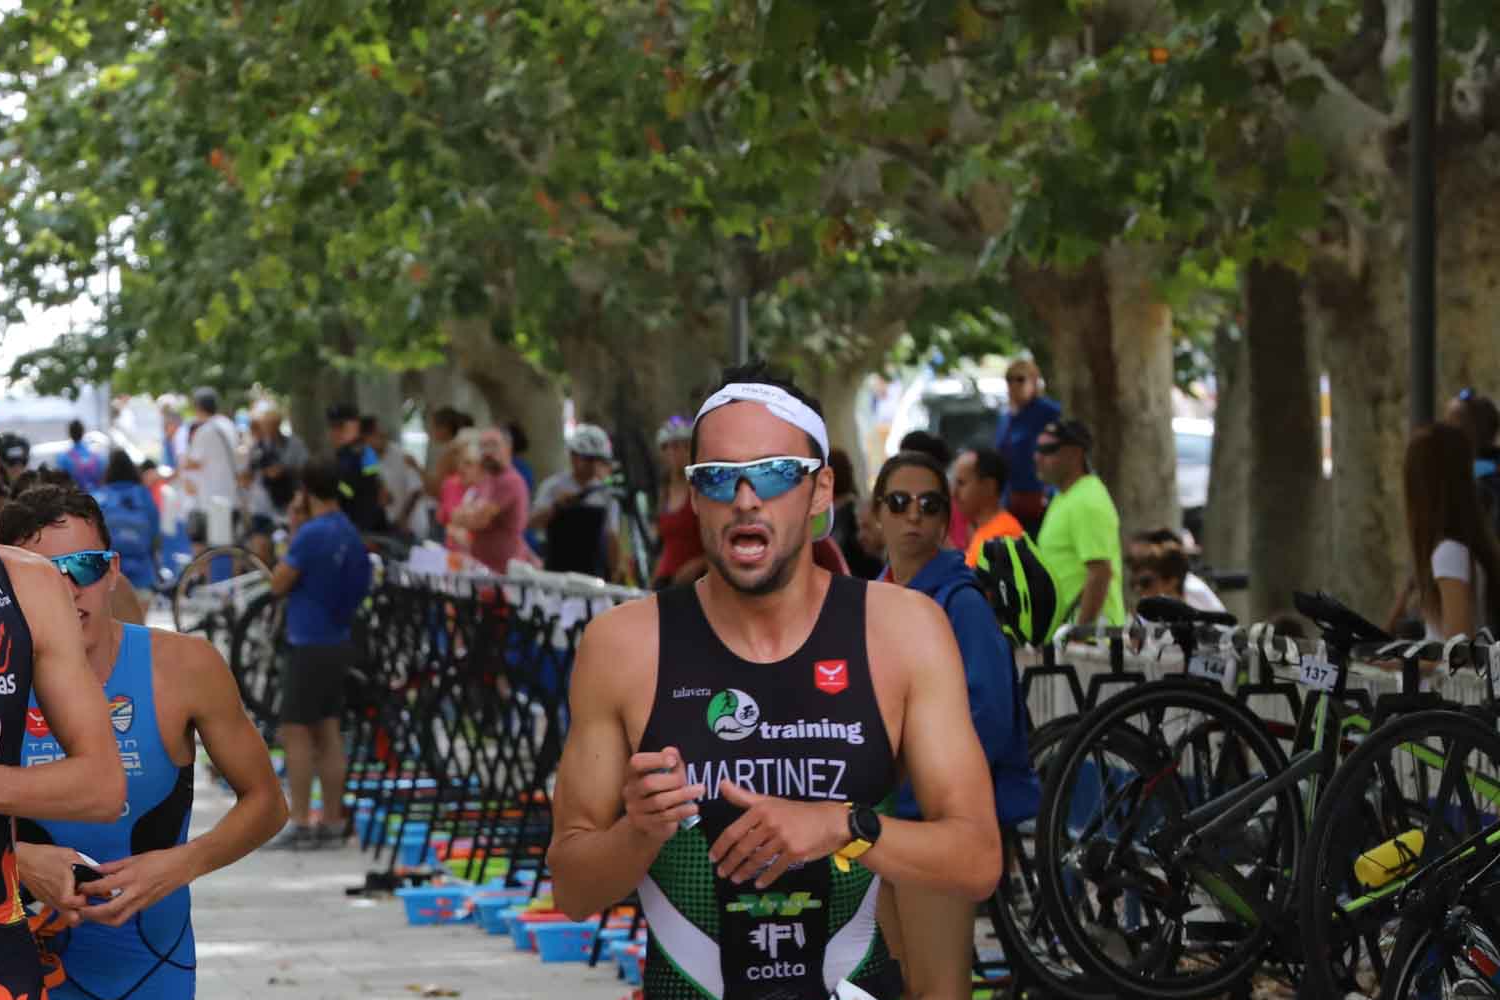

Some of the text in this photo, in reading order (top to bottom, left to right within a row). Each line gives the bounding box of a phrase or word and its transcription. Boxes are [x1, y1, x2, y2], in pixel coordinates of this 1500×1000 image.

[1305, 665, 1328, 683] 137
[759, 718, 865, 745] training
[687, 757, 848, 801] MARTINEZ
